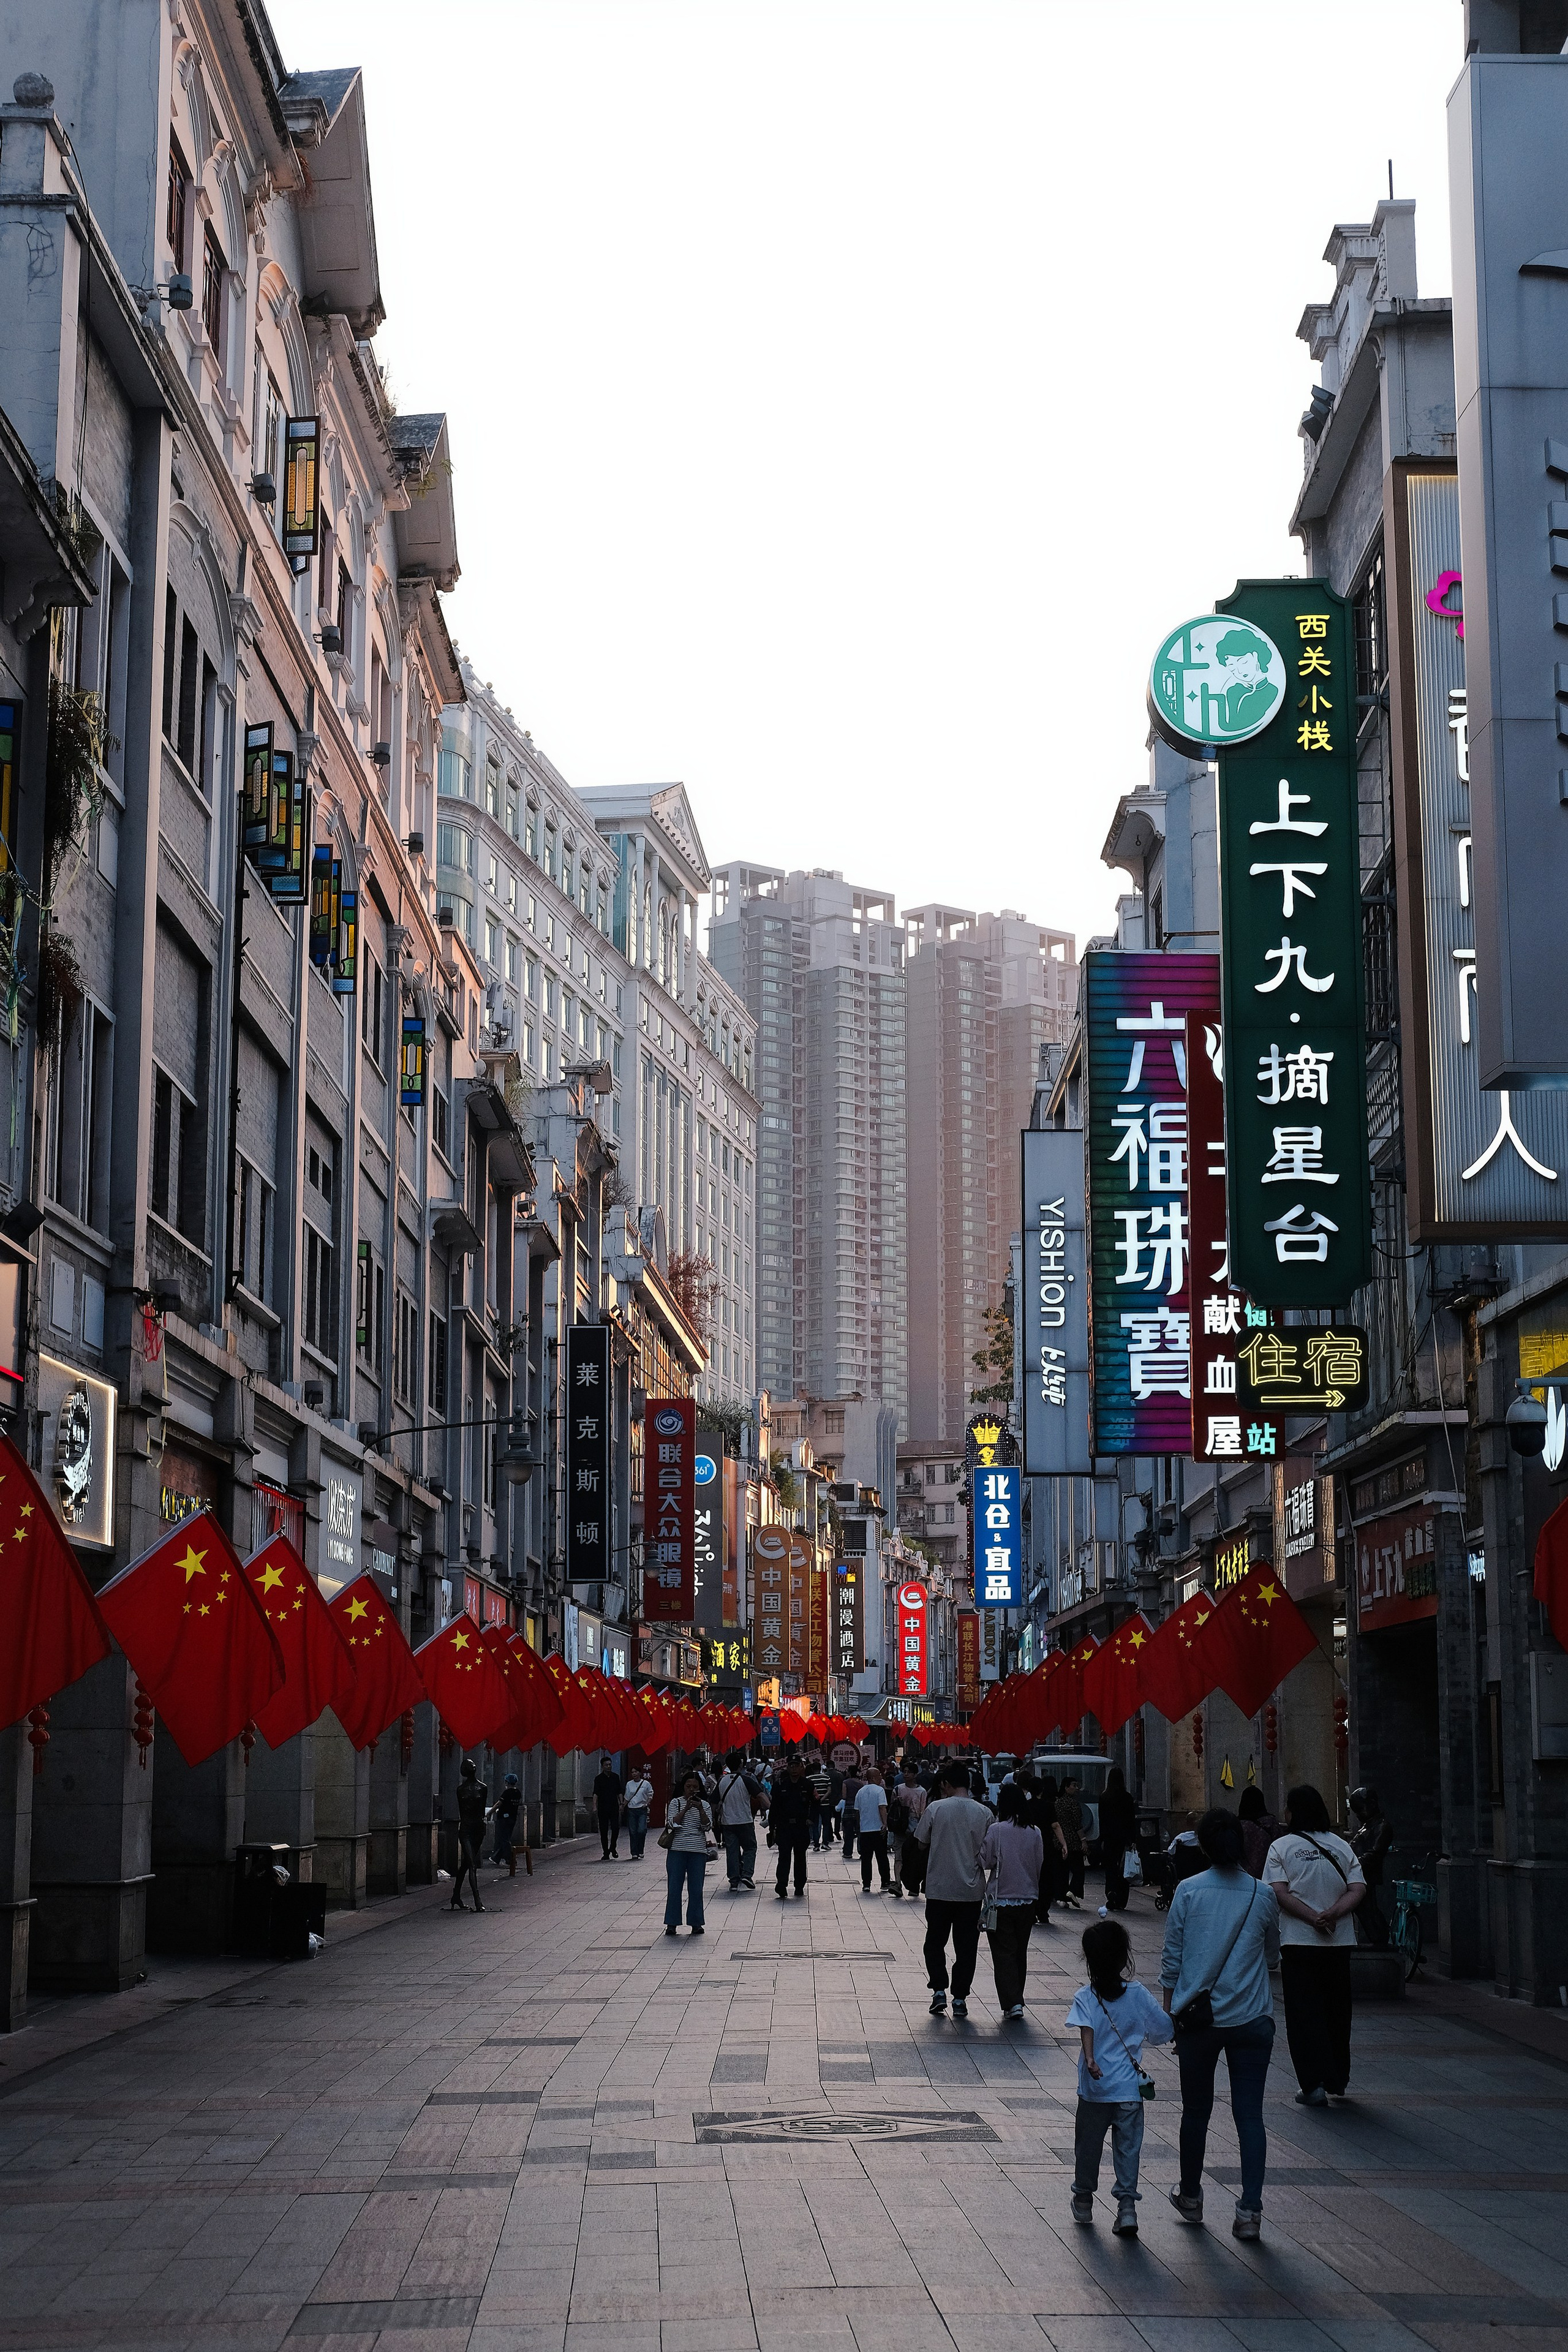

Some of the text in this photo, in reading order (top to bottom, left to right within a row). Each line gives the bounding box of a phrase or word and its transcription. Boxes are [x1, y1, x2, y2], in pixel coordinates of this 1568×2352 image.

[1295, 614, 1333, 752] 西关小栈
[1238, 1330, 1363, 1387] 住宿
[576, 1362, 600, 1545] 莱克斯顿
[658, 1443, 682, 1589] 联合大众眼镜
[1284, 1478, 1314, 1539] 六福珠寶
[761, 1566, 782, 1666] 中国黄金
[839, 1587, 855, 1668] 潮漫酒店
[904, 1616, 921, 1692] 中国黄金
[962, 1621, 974, 1704] 港联长江物管公司
